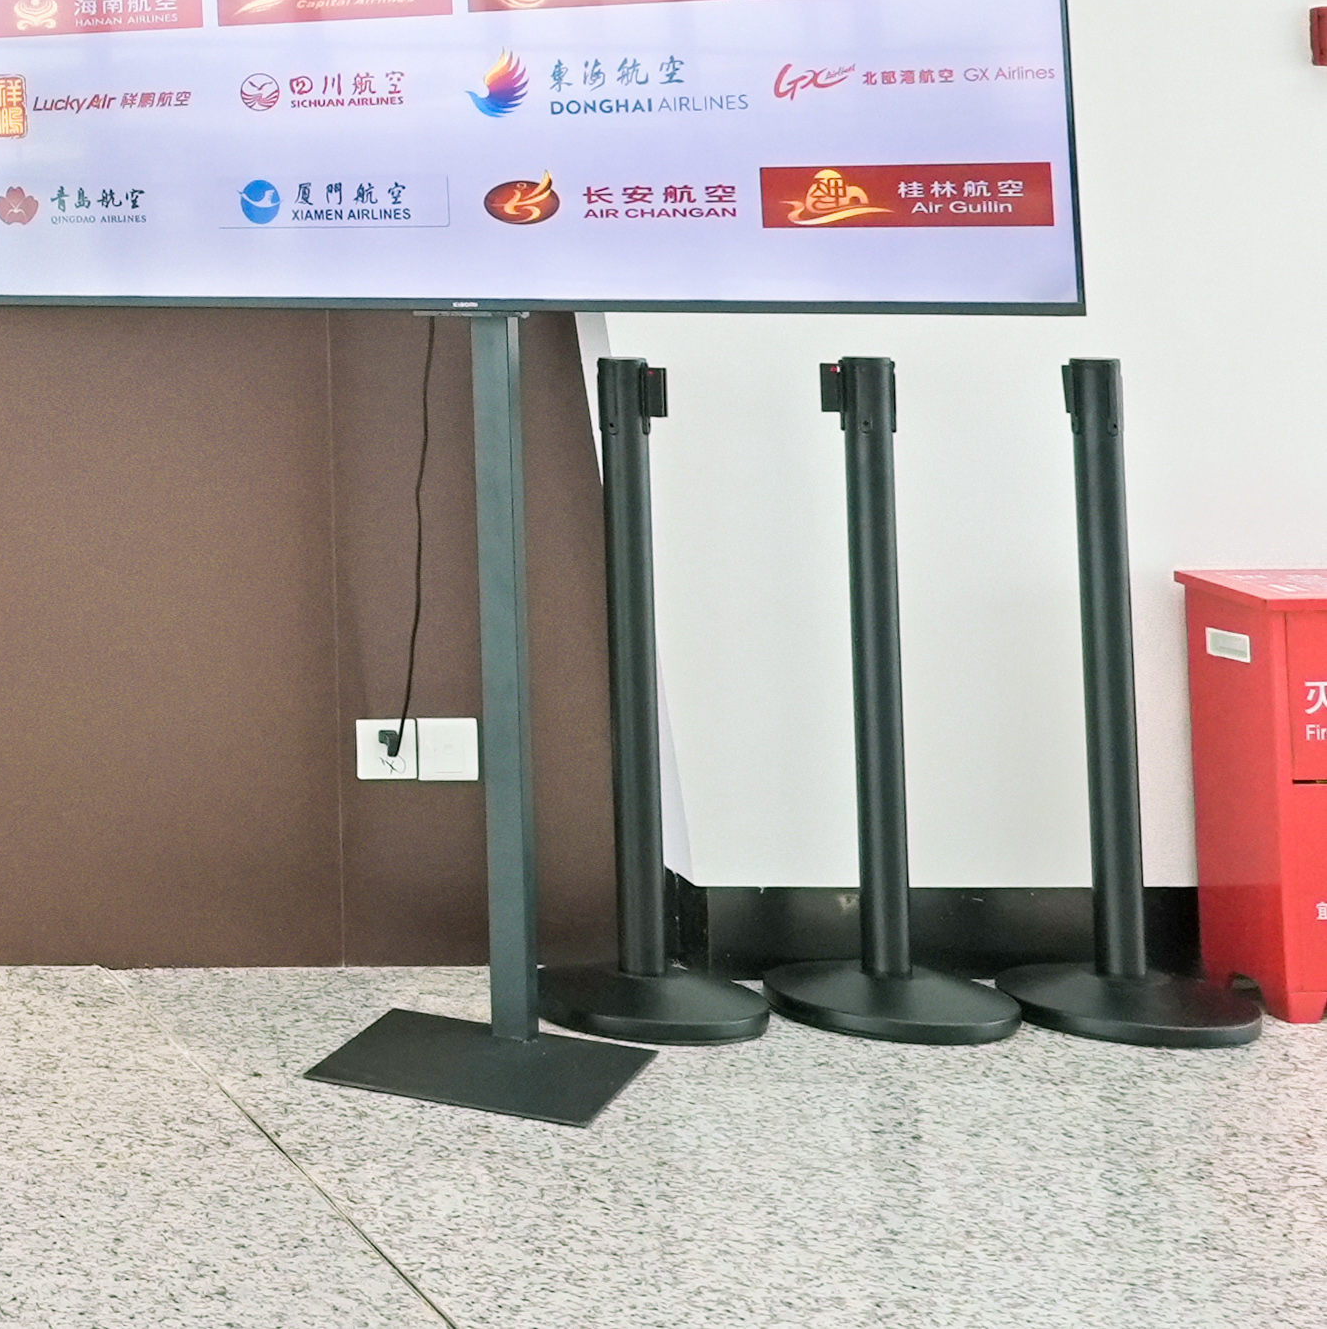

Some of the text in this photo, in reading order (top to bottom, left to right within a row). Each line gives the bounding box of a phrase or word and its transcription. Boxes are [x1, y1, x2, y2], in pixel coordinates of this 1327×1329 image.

[74, 12, 179, 28] HAINAN AIRLINES
[963, 68, 989, 82] GX
[994, 66, 1056, 81] Airlines
[289, 70, 405, 96] 四川航空
[120, 90, 192, 109] 祥鹏航空
[290, 96, 405, 109] SICHUAN AIRLINES
[550, 94, 749, 115] DONGHAI AIRLINES
[582, 183, 738, 205] 长安航空
[898, 179, 1025, 199] 桂林航空
[291, 207, 412, 222] XIAMEN AIRLINES
[582, 207, 738, 220] AIR CHANGAN
[911, 200, 1013, 214] Air Guilin
[50, 214, 147, 225] QINGDAO AIRLINES
